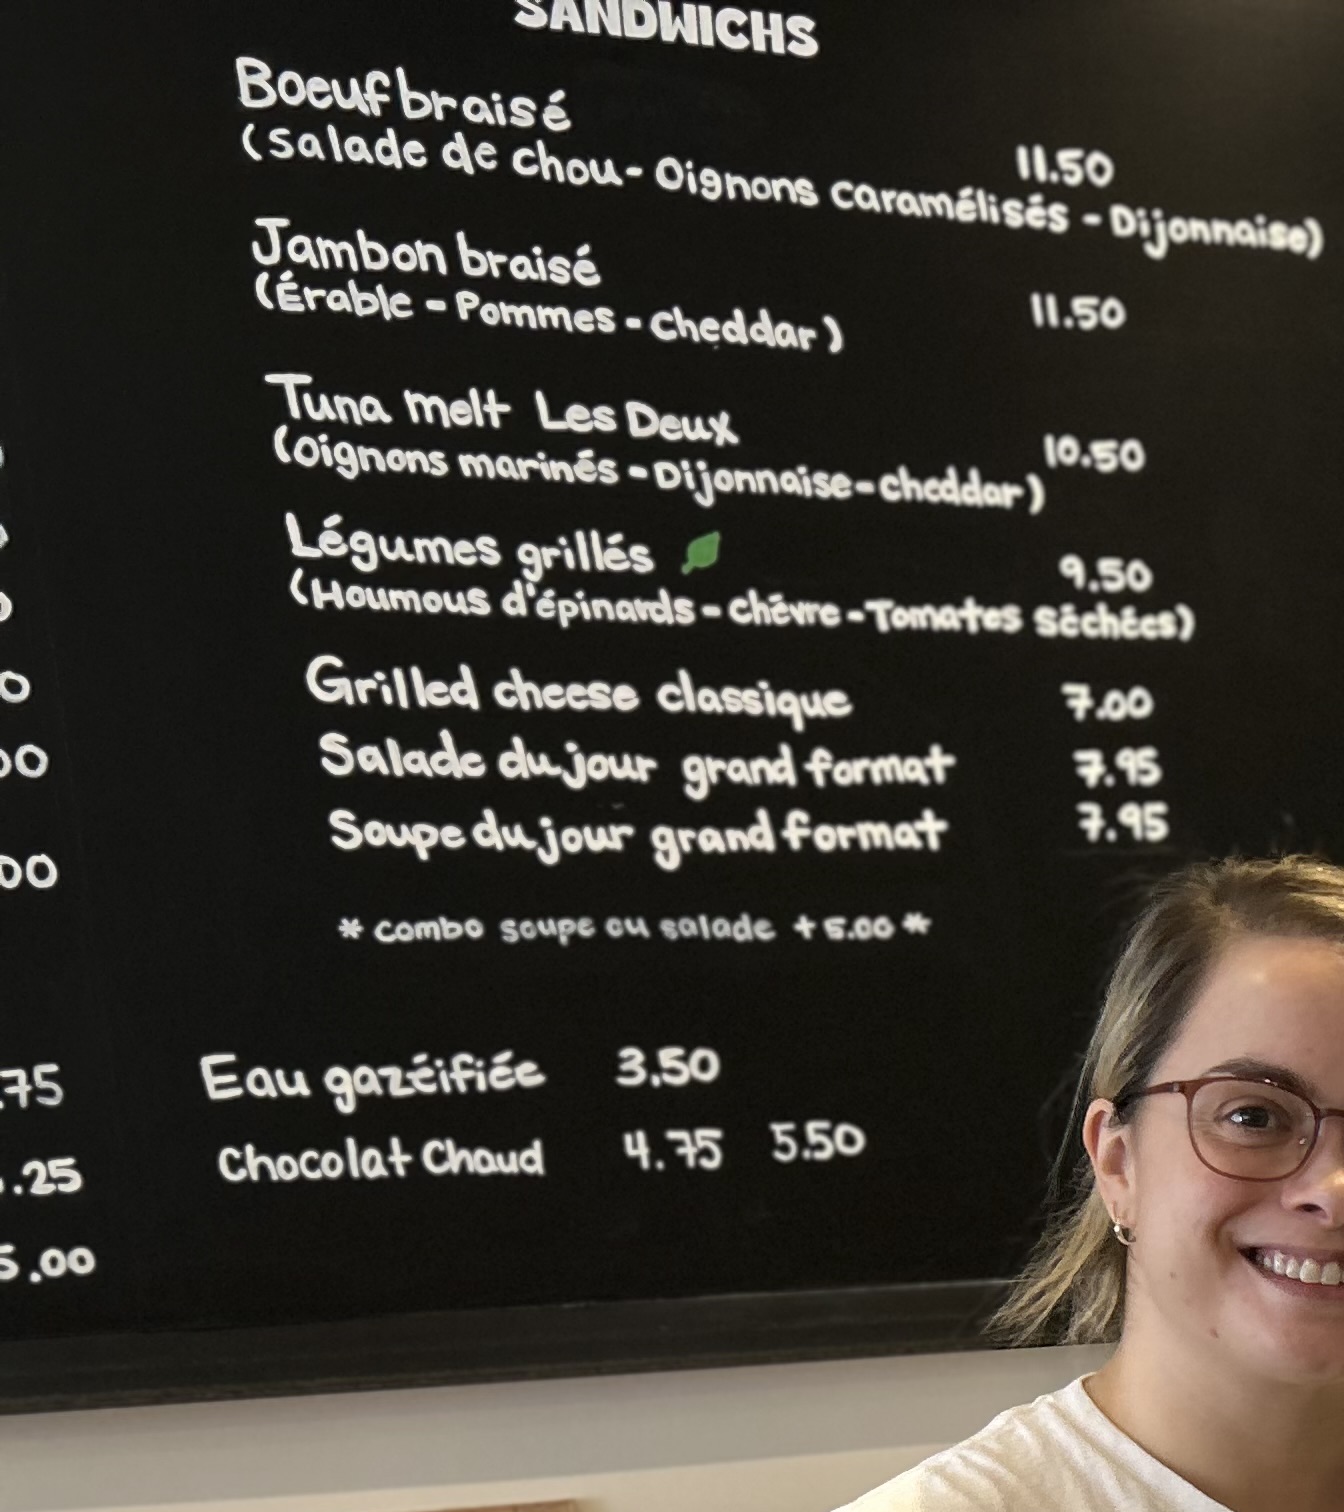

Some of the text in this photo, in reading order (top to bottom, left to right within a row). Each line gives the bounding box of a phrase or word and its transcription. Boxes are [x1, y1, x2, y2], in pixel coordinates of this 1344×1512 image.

[514, 0, 819, 57] SANDWICHS
[396, 67, 571, 132] braisé
[442, 132, 497, 175] de
[1017, 145, 1114, 187] 11.50
[252, 218, 601, 286] Jambon braisé
[1031, 293, 1126, 330] 11.50
[264, 373, 739, 446] Tuna melt Les Deux
[458, 449, 619, 484] marinés
[1044, 434, 1145, 473] 10.50
[286, 512, 655, 584] Légumes grillés
[1059, 554, 1153, 592] 9.50
[306, 655, 1154, 732] Grilled cheese classique 7.00
[319, 729, 486, 779] Salade
[682, 743, 797, 801] grand
[804, 744, 956, 787] format
[1074, 747, 1162, 787] 7.95
[329, 809, 466, 861] Soupe
[650, 811, 776, 871] grand
[781, 809, 948, 852] format
[1077, 802, 1169, 842] 7.95
[374, 916, 484, 943] combo
[500, 918, 595, 946] soupe
[605, 917, 650, 938] ou
[660, 913, 776, 942] salade
[200, 1047, 720, 1114] Eau gazéifiée 3.50
[218, 1120, 866, 1182] Chocolat Chaud 4.75 5.50
